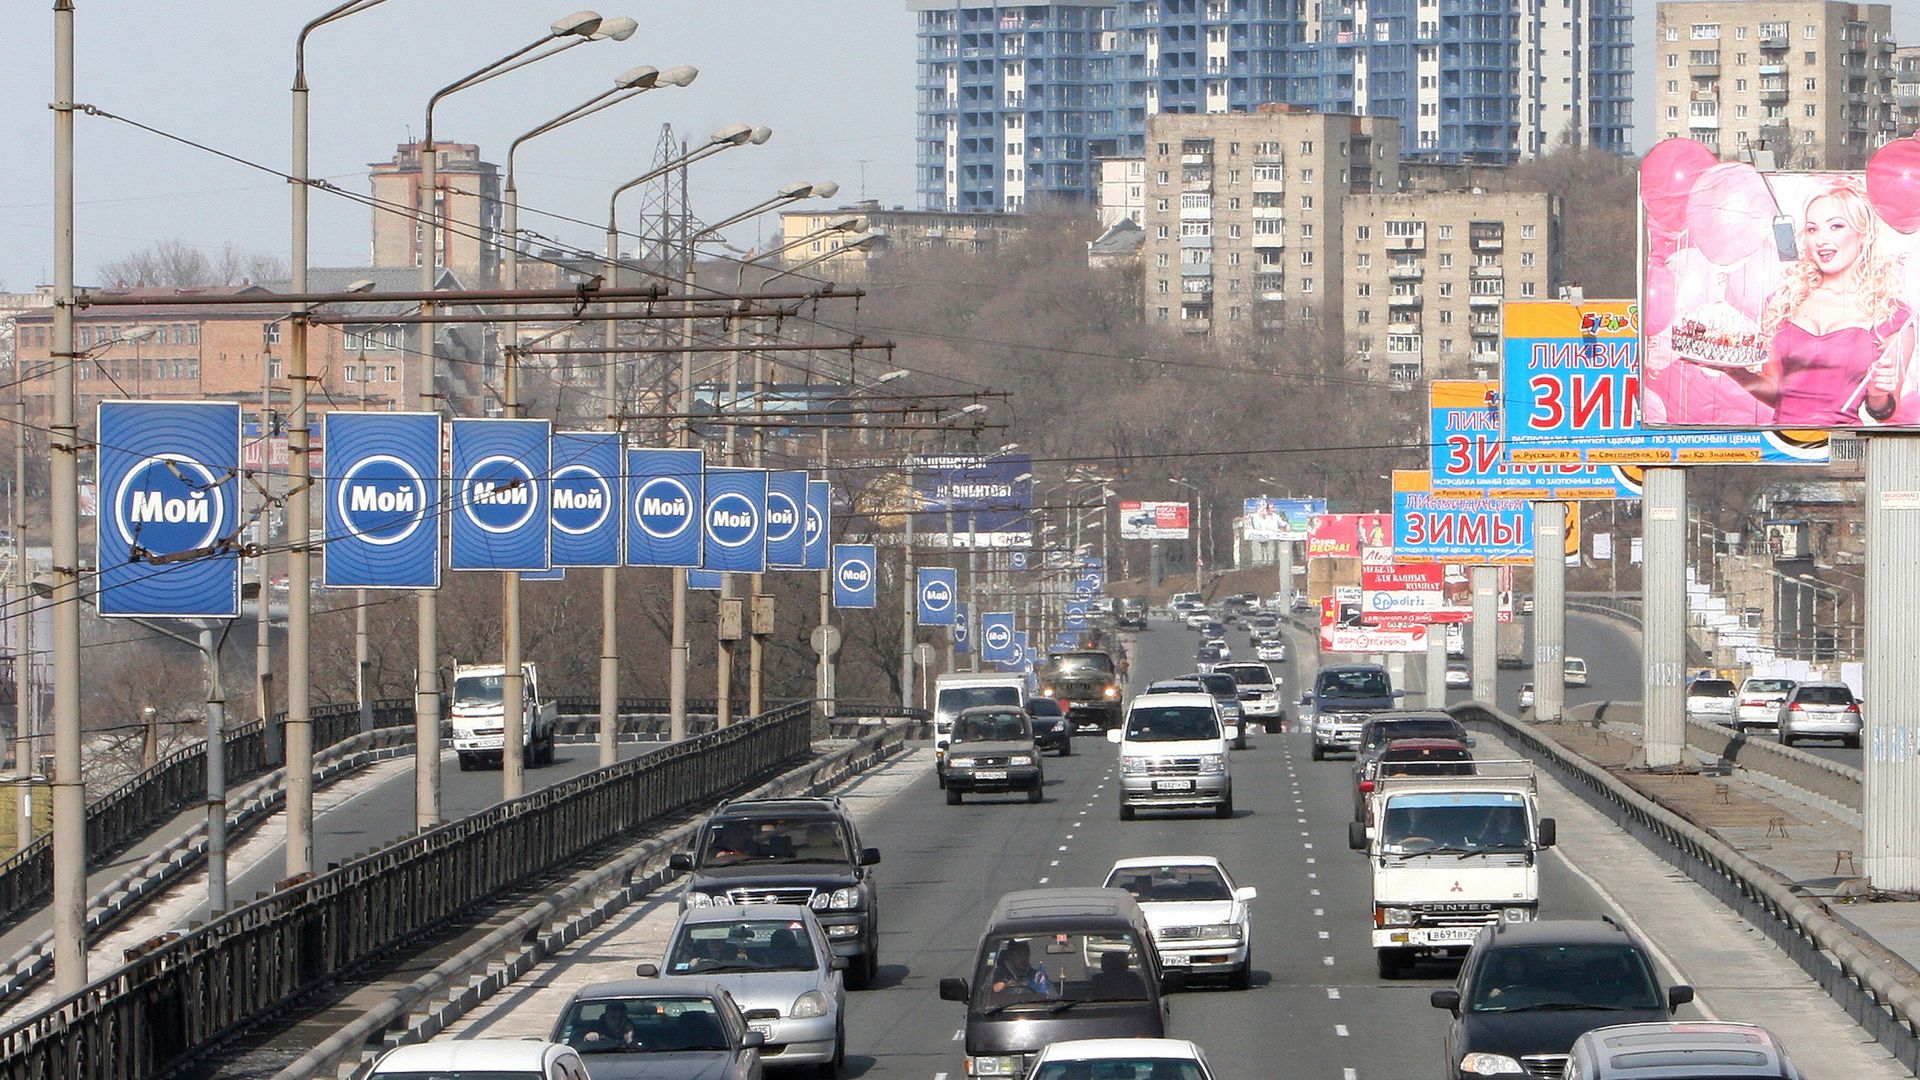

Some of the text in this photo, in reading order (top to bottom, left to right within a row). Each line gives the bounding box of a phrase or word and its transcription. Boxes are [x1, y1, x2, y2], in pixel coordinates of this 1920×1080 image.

[1529, 343, 1638, 373] ЛИКВИ
[1652, 434, 1665, 444] ПО
[1667, 434, 1727, 444] ЗАКУПОЧНЫМ
[1730, 434, 1760, 445] ЦЕНАМ
[350, 485, 414, 512] Мой
[473, 482, 528, 504] Мой
[553, 488, 602, 509] Мой
[131, 490, 208, 523] Мой
[643, 498, 685, 516] Мой
[713, 510, 751, 527] Мой
[768, 510, 792, 524] ой
[1405, 512, 1523, 546] ЗИМЫ
[843, 570, 867, 581] Мой
[1422, 903, 1492, 912] CANTER
